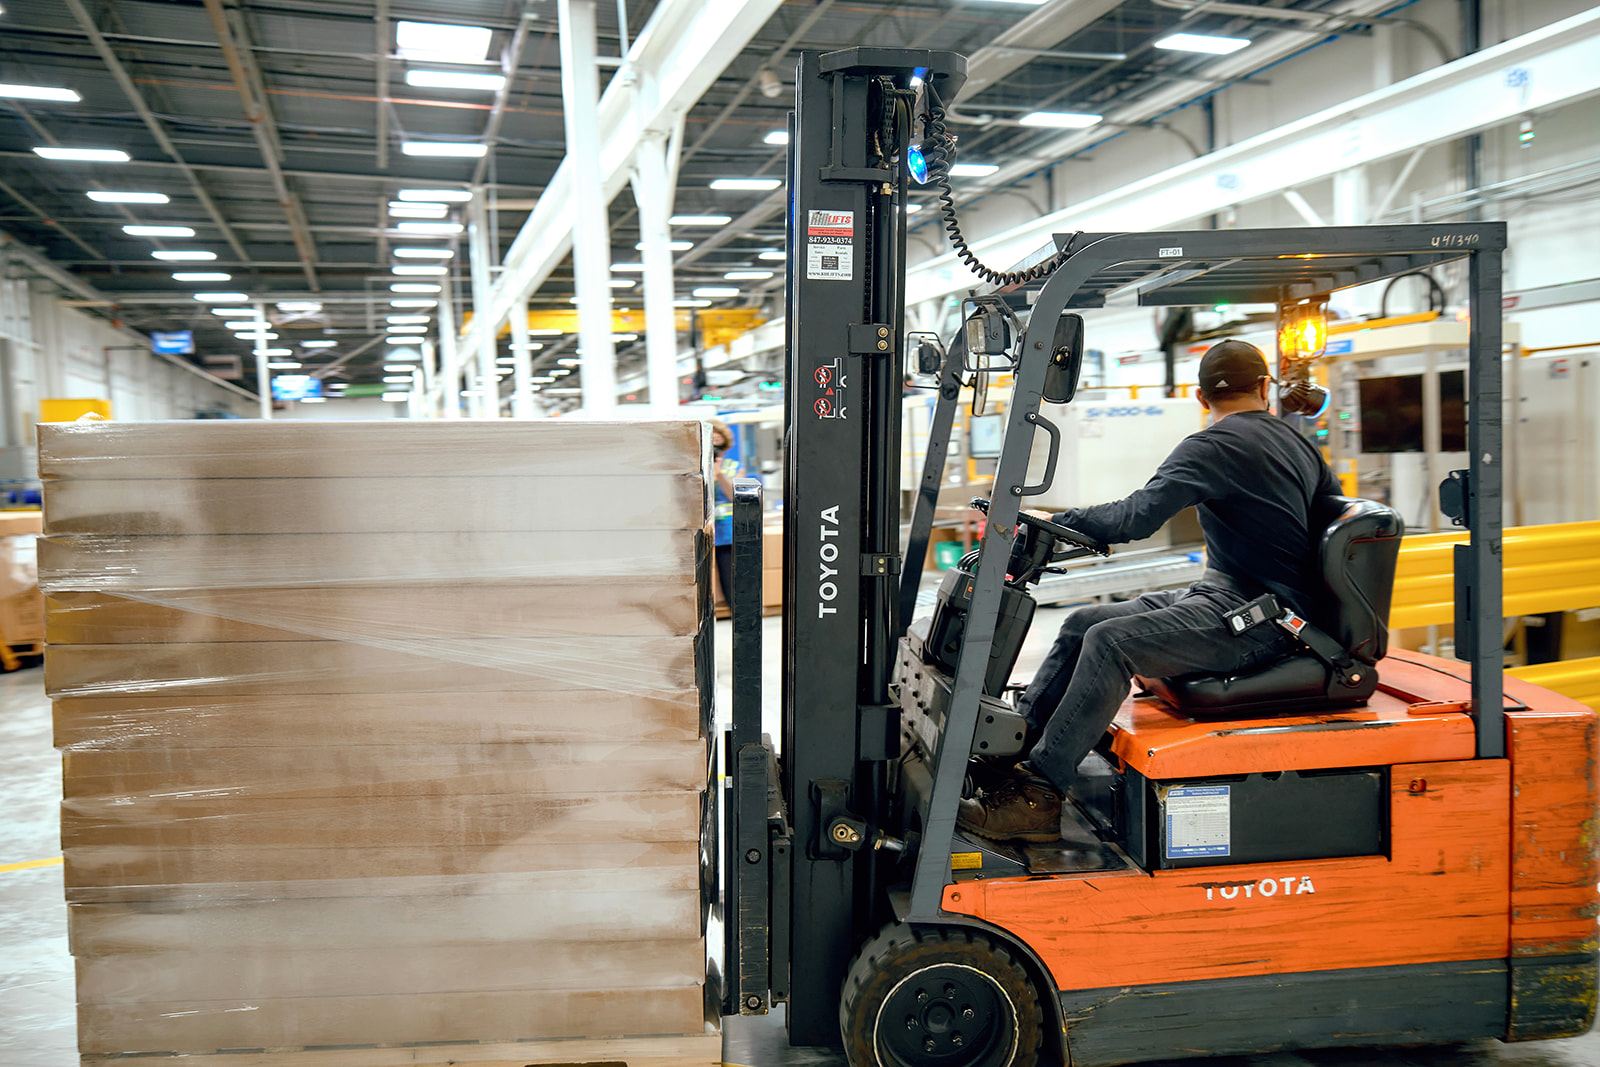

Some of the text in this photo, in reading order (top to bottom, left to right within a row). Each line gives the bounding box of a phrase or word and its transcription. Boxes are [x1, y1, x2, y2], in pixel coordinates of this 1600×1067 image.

[808, 236, 852, 244] 847-923-0374
[1160, 248, 1181, 256] FT-01
[818, 504, 839, 619] TOYOTA
